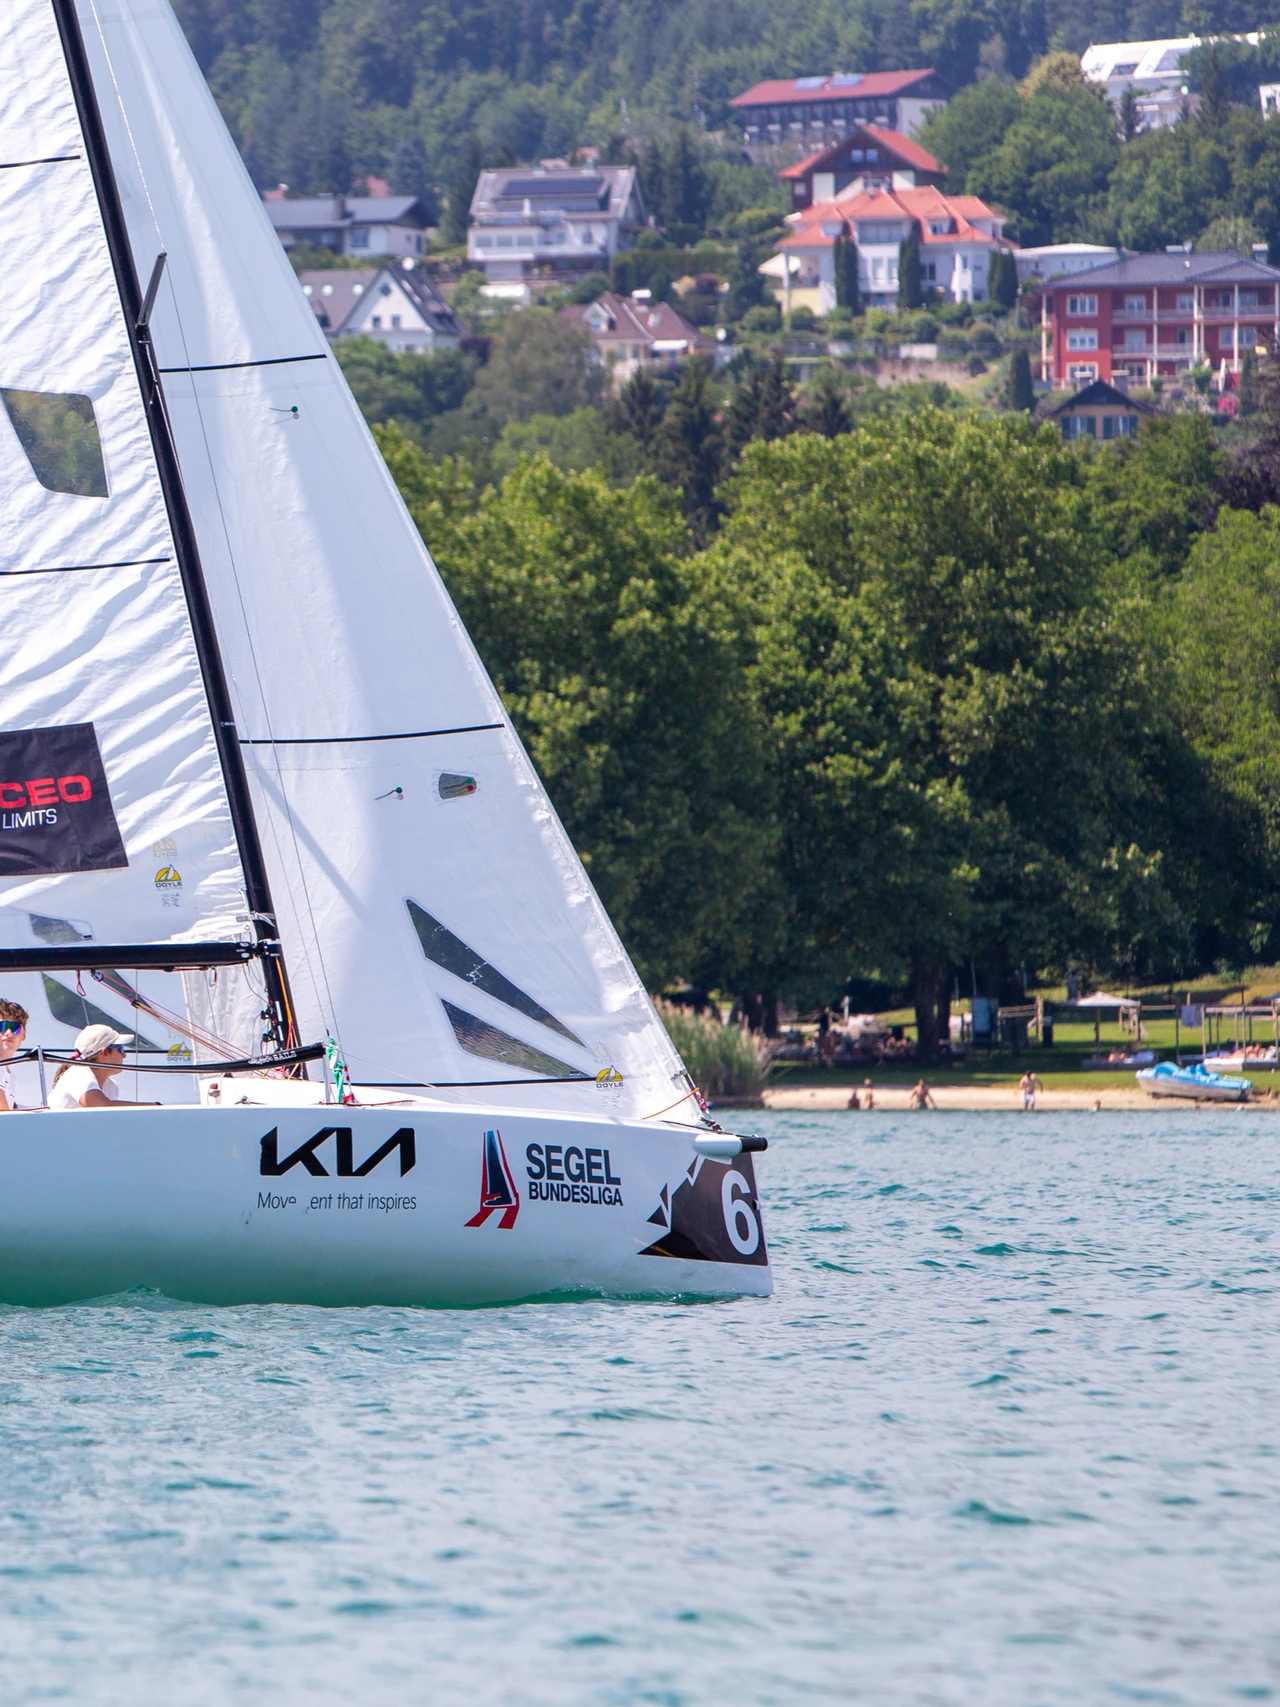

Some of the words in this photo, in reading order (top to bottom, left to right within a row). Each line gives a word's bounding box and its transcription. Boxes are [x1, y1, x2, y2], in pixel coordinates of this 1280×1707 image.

[2, 808, 58, 830] LIMITS
[595, 1081, 624, 1089] DOYLE
[260, 1126, 417, 1178] KIA
[525, 1142, 622, 1186] SEGEL
[337, 1193, 364, 1209] that
[367, 1193, 417, 1214] inspires
[528, 1181, 624, 1206] BUNDESLIGA
[721, 1169, 760, 1256] 6
